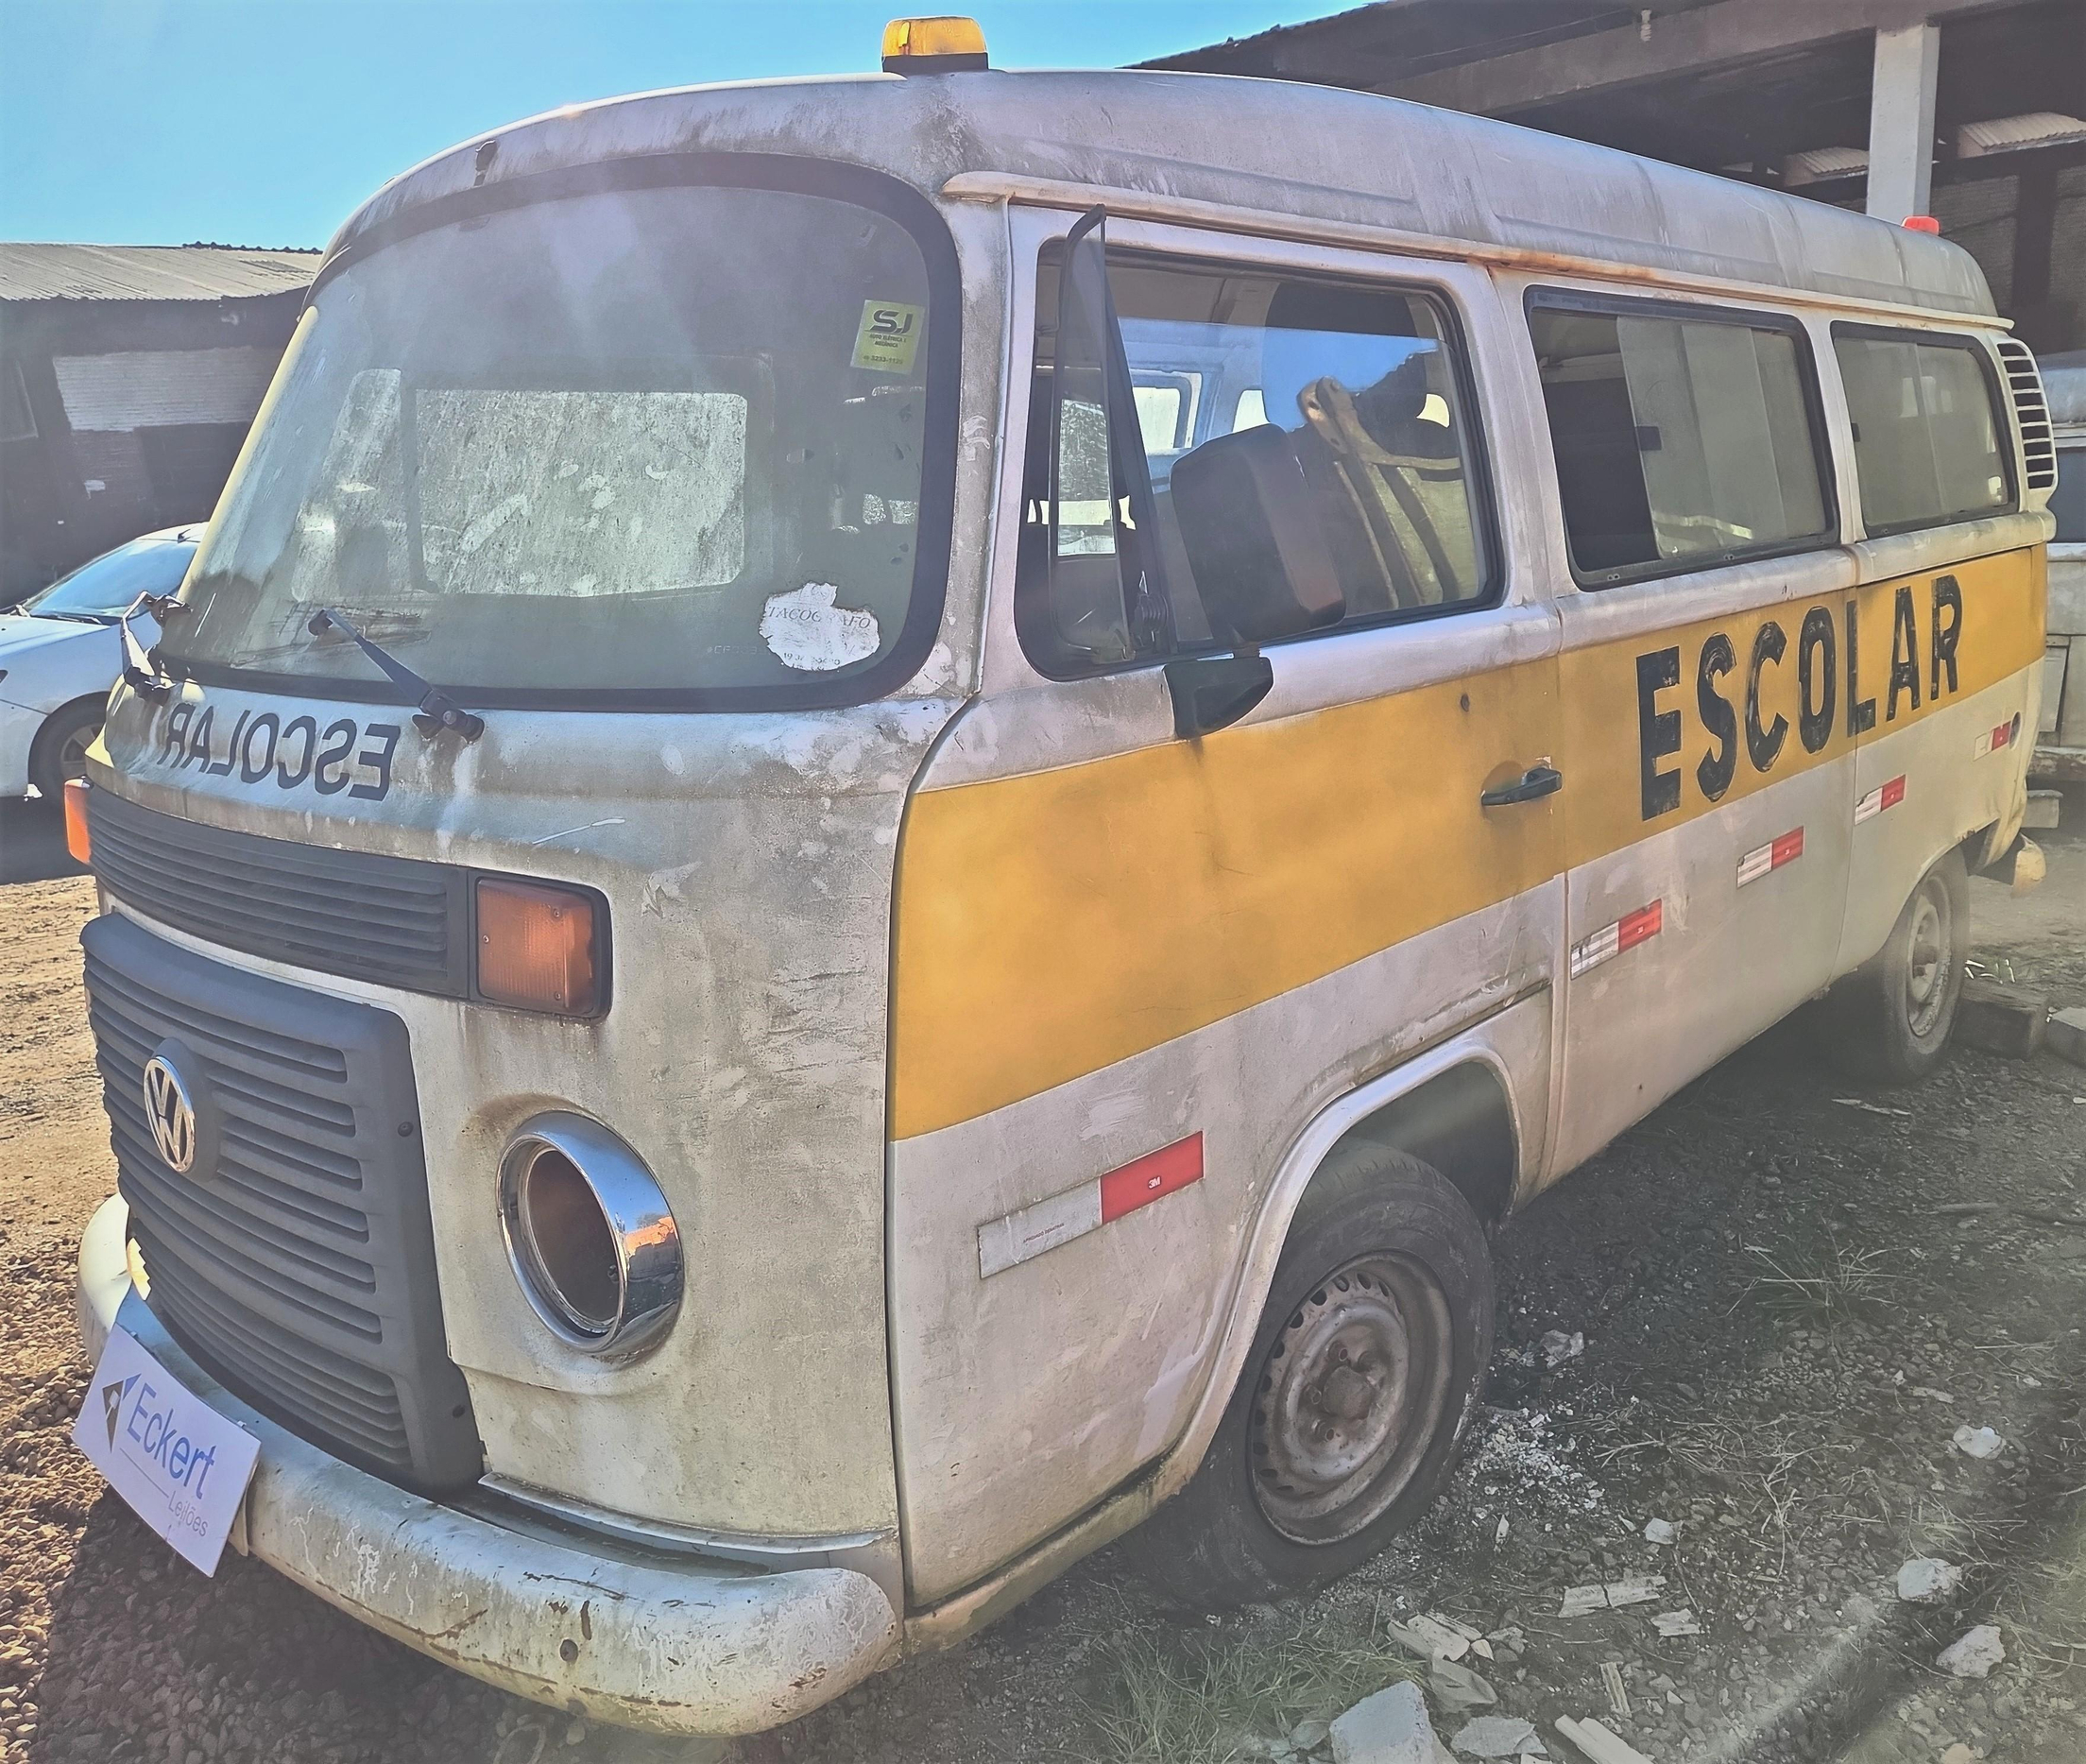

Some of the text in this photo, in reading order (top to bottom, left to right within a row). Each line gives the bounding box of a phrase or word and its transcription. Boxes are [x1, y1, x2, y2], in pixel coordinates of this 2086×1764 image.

[1635, 574, 1963, 821] ESCOLAR
[1148, 1176, 1161, 1189] 3M
[127, 1382, 217, 1500] Eckert
[167, 1490, 209, 1537] Leilões
